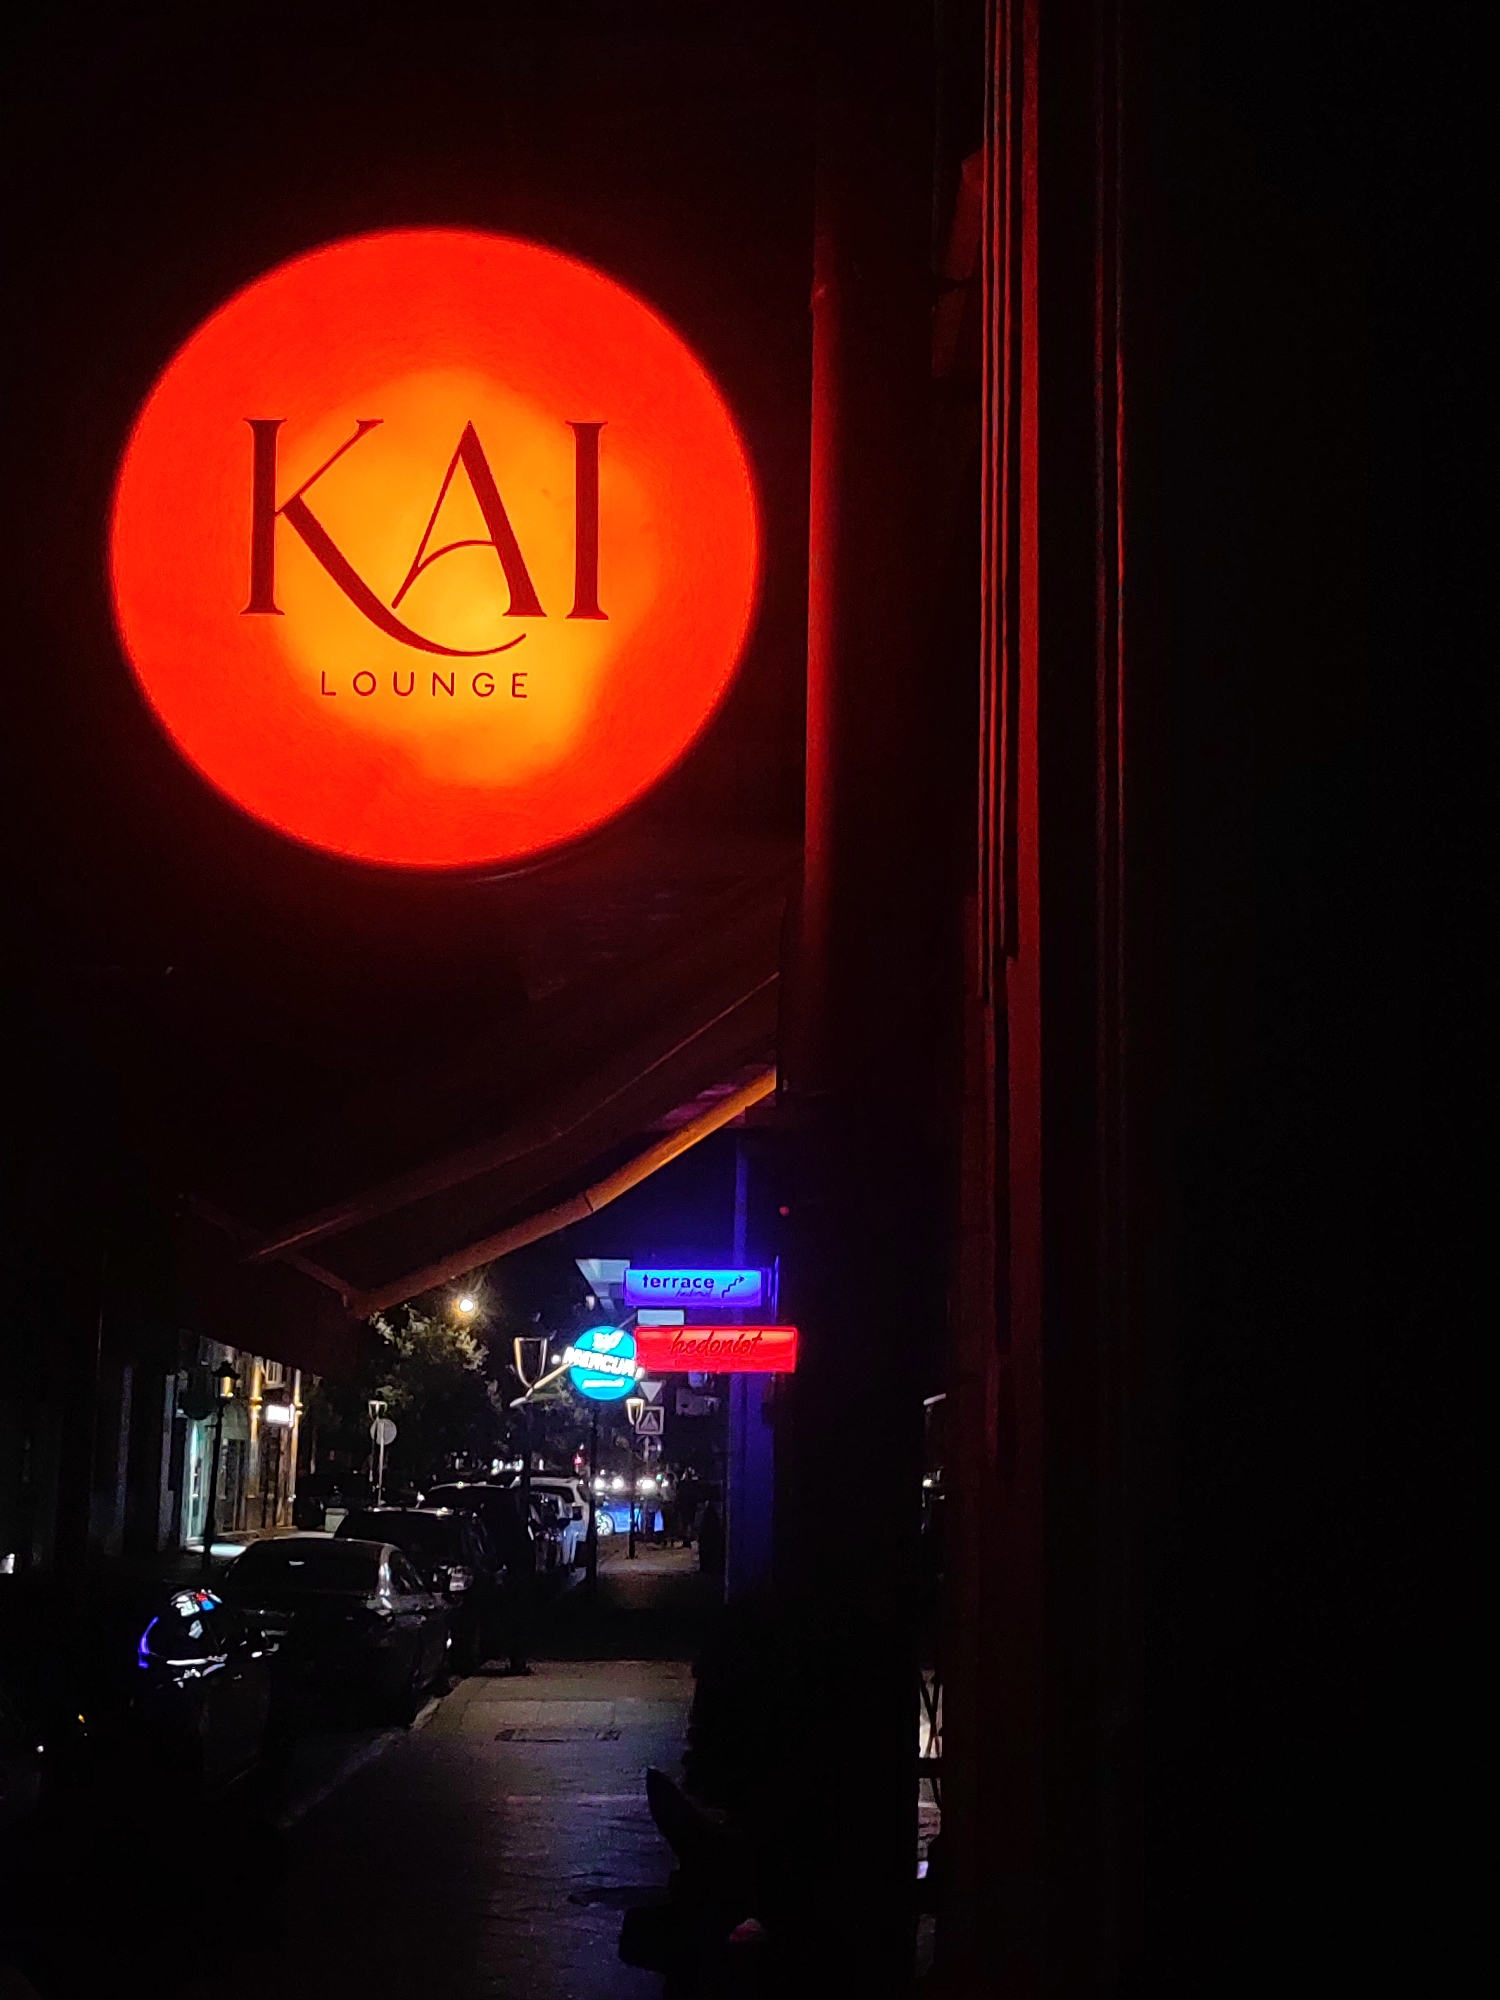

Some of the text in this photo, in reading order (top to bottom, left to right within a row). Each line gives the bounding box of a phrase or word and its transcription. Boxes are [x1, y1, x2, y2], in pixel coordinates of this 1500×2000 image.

[238, 417, 609, 657] KAI
[320, 670, 528, 698] LOUNGE
[642, 1273, 715, 1289] terrace
[669, 1330, 763, 1356] hedonist
